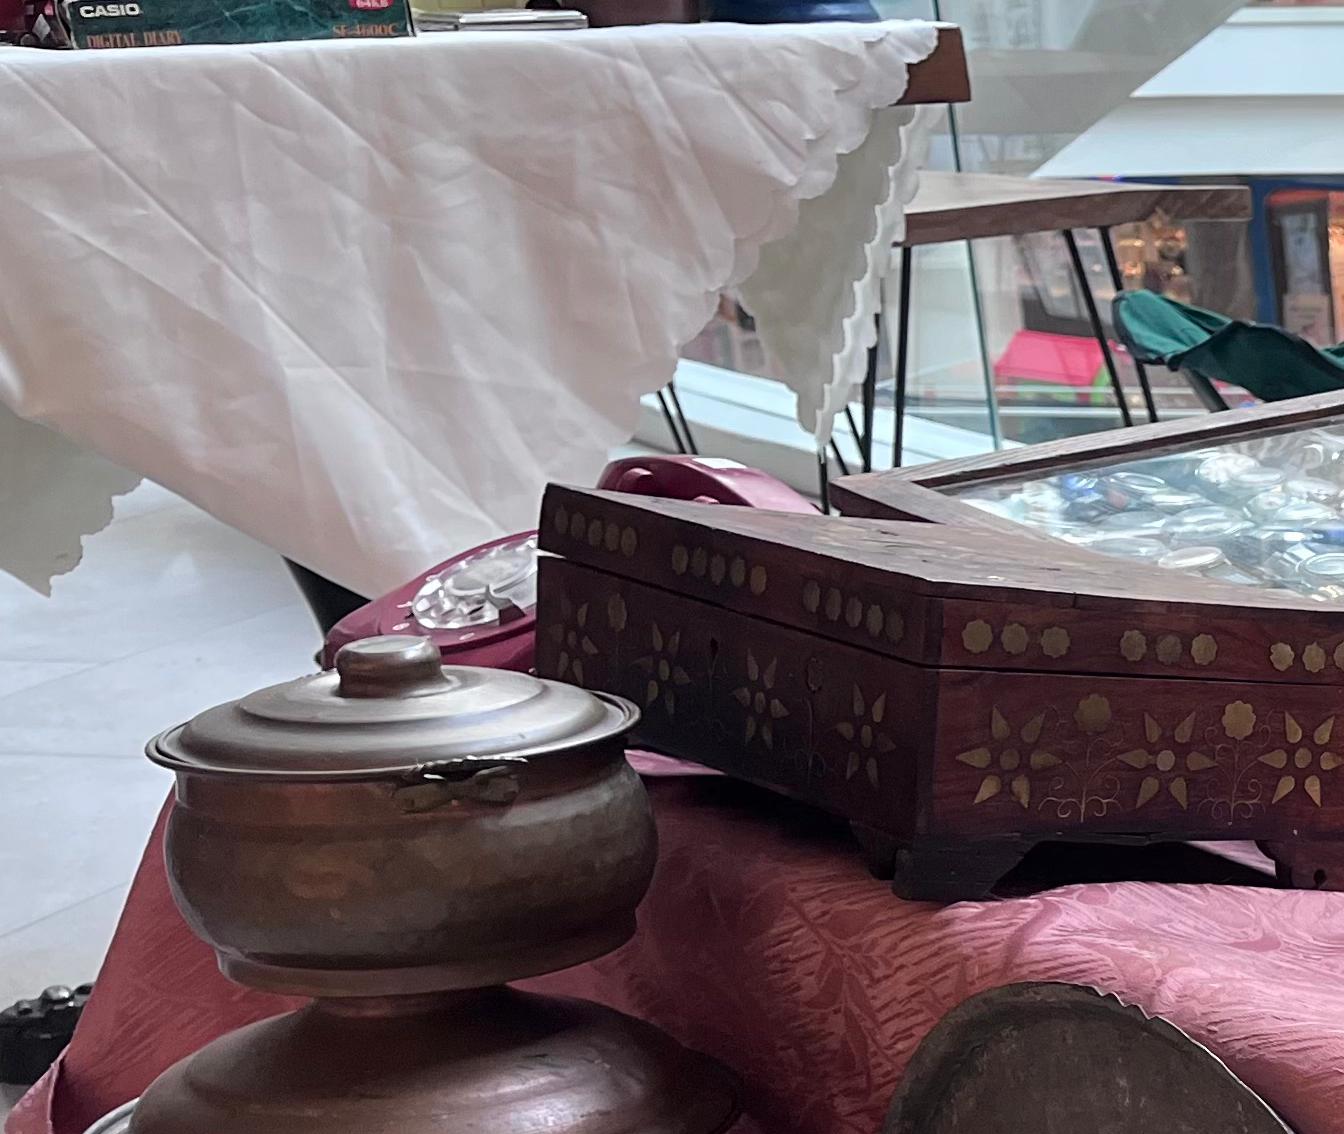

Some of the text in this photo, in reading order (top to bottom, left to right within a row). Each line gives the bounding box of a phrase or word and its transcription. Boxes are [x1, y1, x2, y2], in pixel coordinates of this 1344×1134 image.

[79, 3, 141, 18] CASIO
[86, 30, 182, 48] DIGITAL DIARY
